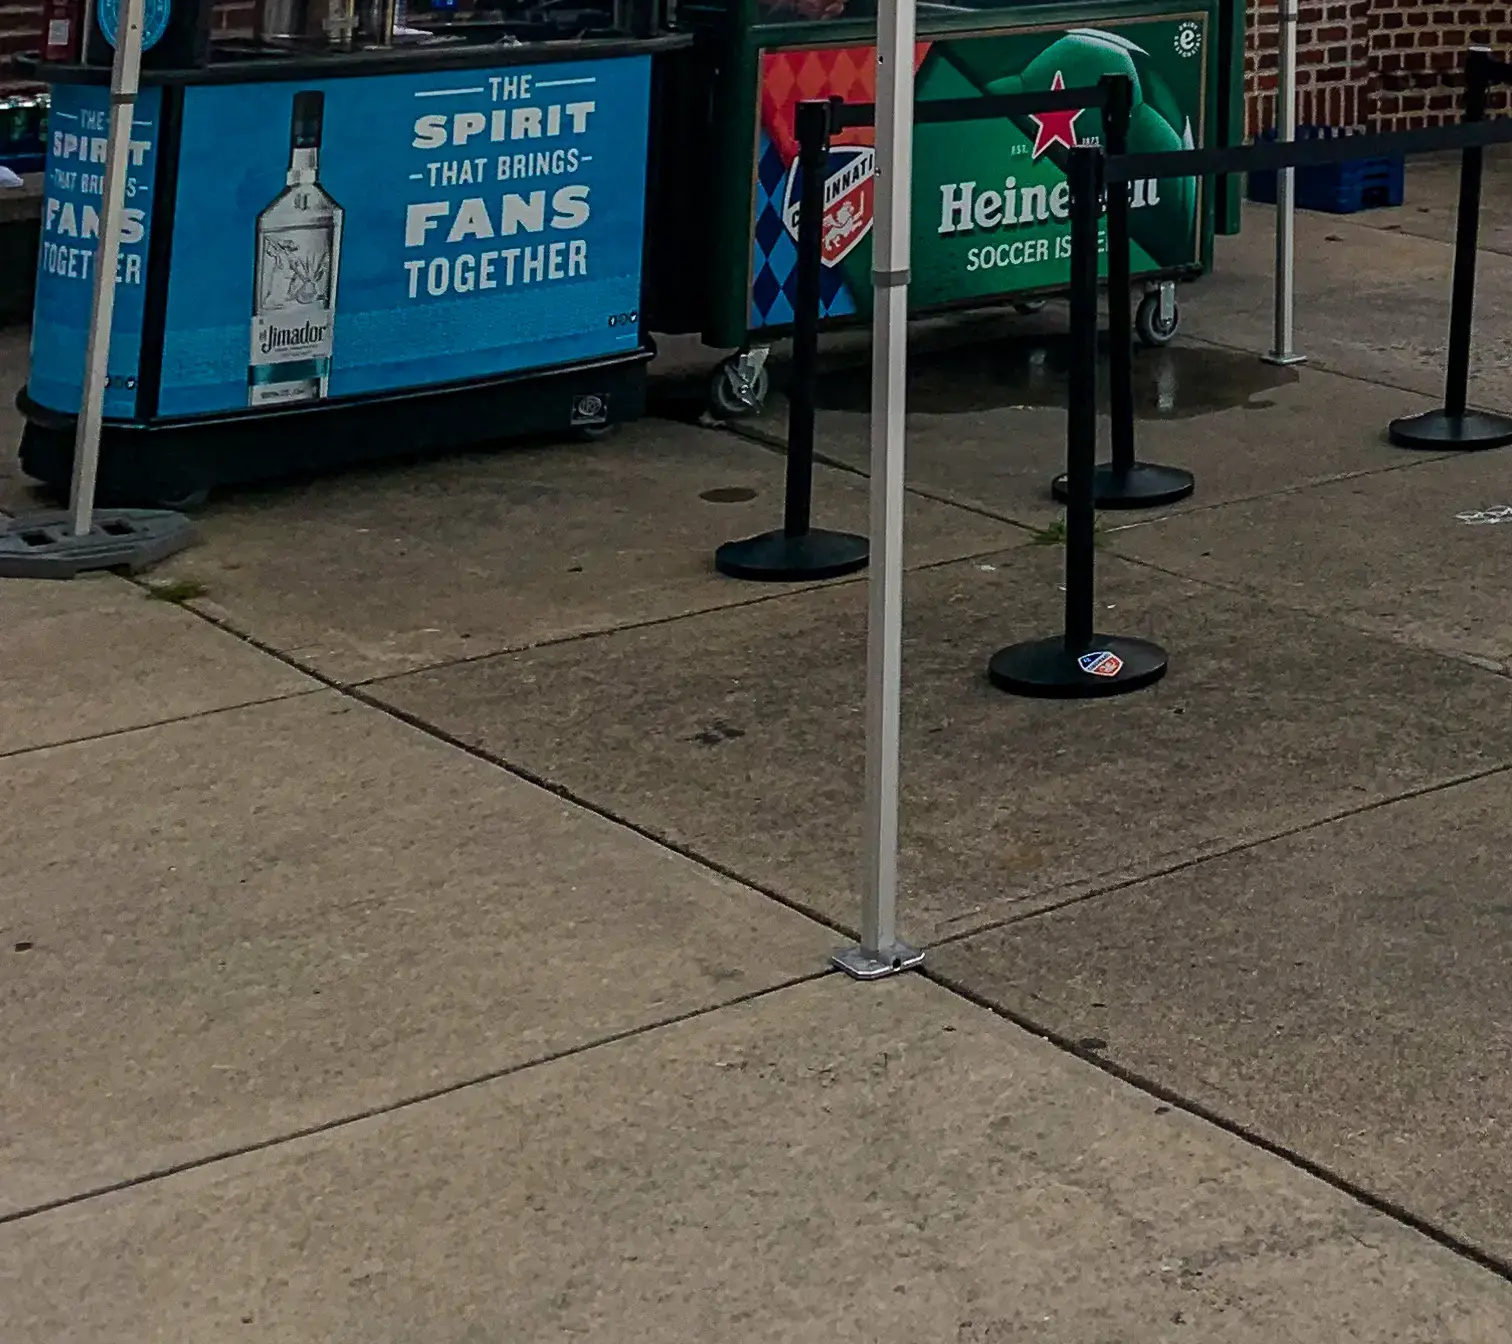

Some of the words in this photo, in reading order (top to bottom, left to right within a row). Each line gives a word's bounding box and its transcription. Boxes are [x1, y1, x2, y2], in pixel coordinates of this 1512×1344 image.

[489, 75, 532, 102] THE
[80, 109, 106, 130] THE
[412, 101, 595, 149] SPIRIT
[53, 131, 151, 166] SPIRT
[427, 158, 487, 187] THAT
[497, 148, 579, 181] BRINGS
[54, 169, 77, 192] THAT
[81, 174, 137, 197] BRIS
[792, 154, 873, 228] CINNATI
[46, 198, 145, 243] FANS
[405, 185, 590, 247] FANS
[938, 176, 1161, 233] Heinen
[43, 242, 140, 284] TOGETER
[404, 240, 587, 298] TOGETHER
[967, 240, 1048, 271] SOCCER
[1055, 235, 1072, 259] IS
[261, 320, 326, 353] Jimador
